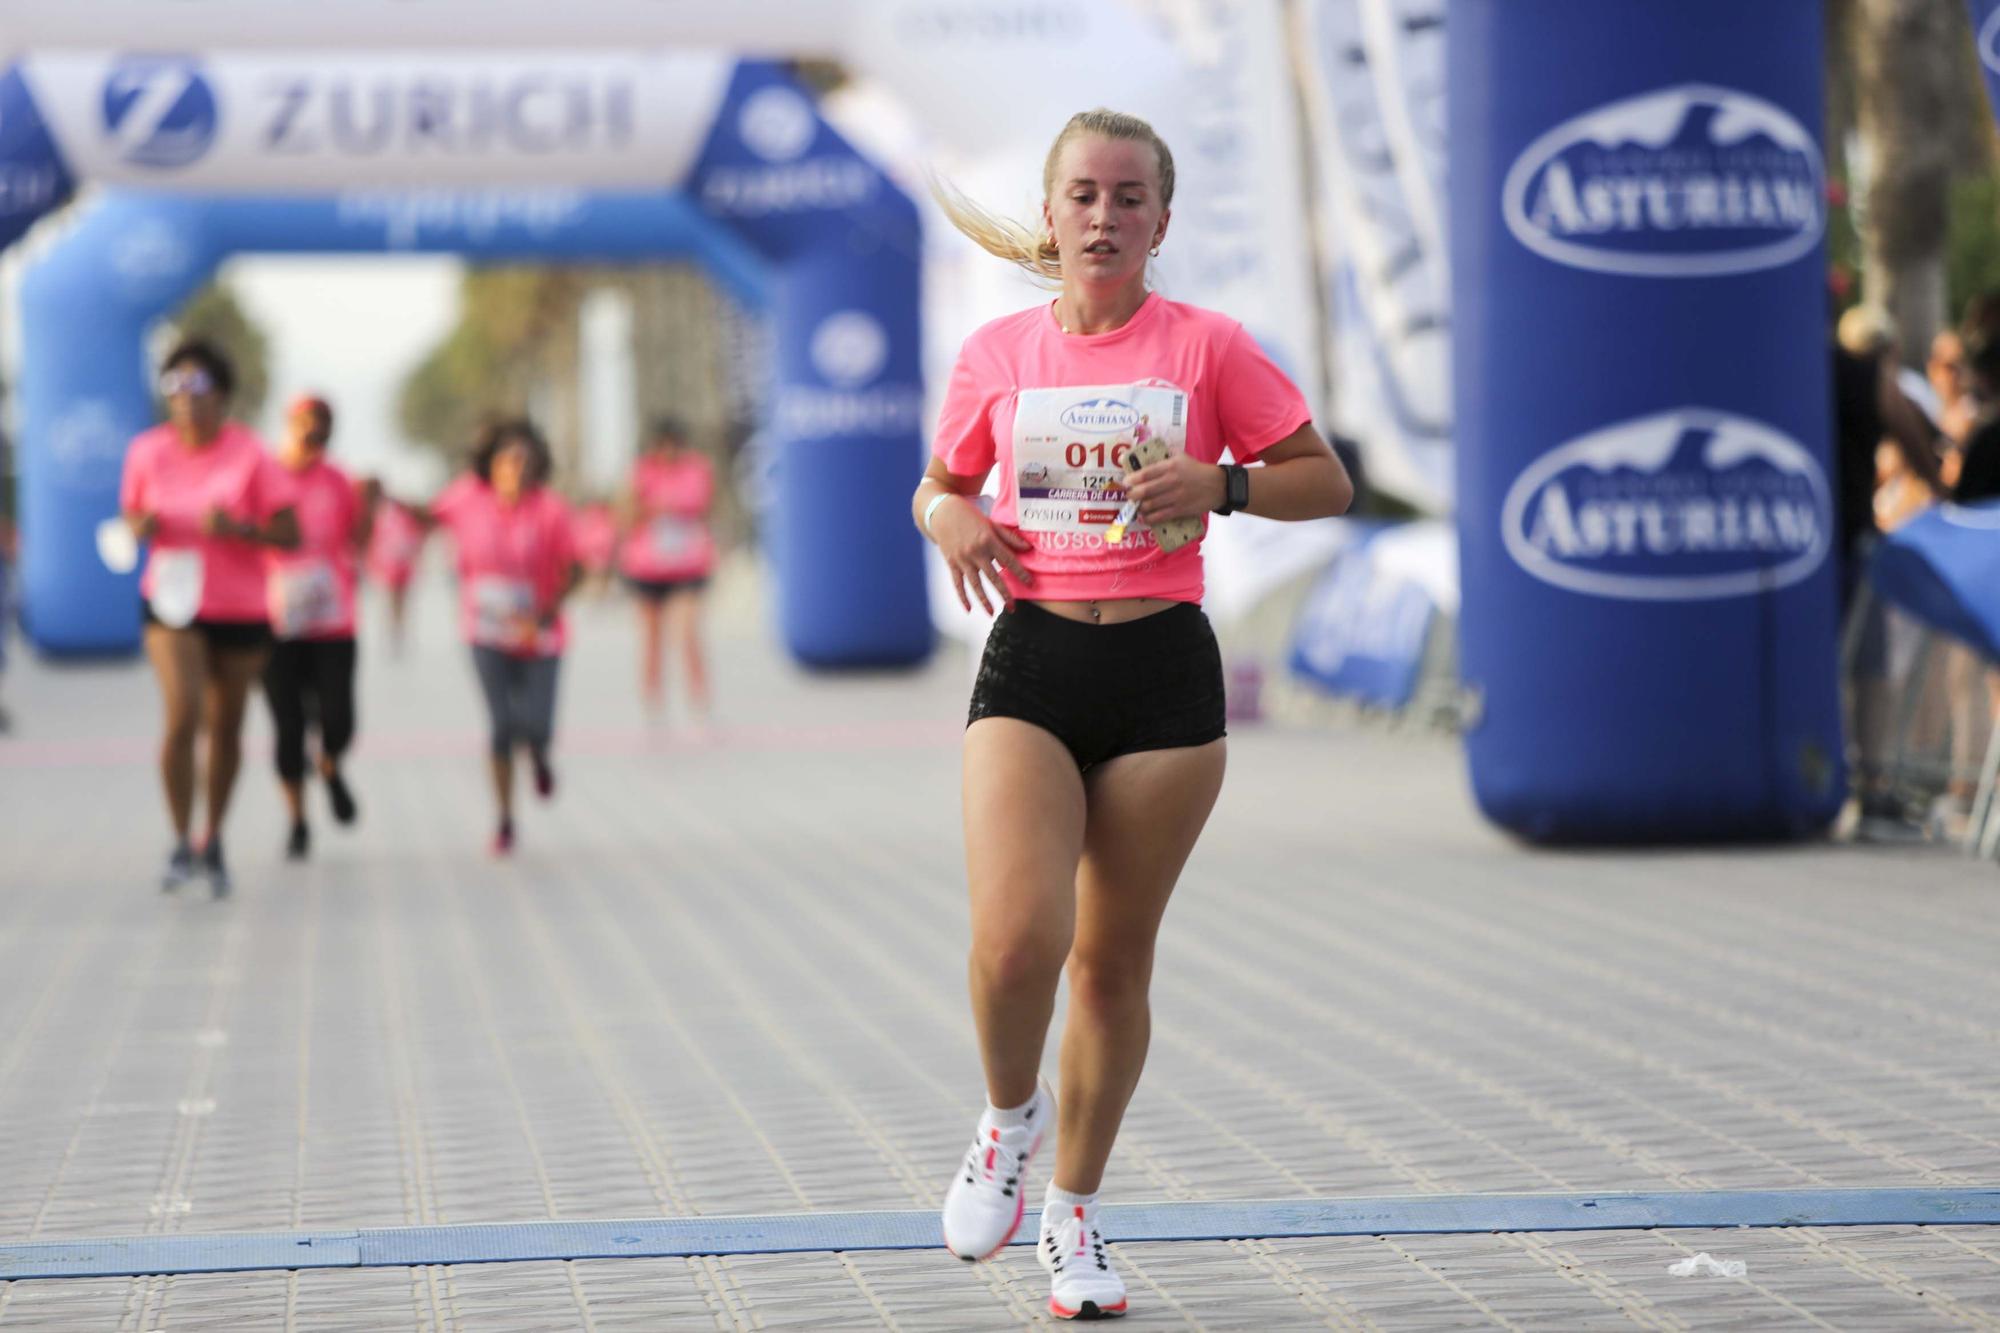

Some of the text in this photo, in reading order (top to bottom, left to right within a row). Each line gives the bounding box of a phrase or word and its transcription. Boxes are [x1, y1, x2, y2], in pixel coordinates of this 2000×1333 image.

[260, 70, 636, 156] ZURICH
[1065, 411, 1133, 425] ASTURIANA
[1048, 489, 1088, 499] CARRERA
[1091, 490, 1103, 500] DE
[1106, 491, 1117, 500] LA
[1024, 508, 1072, 520] OYSHO
